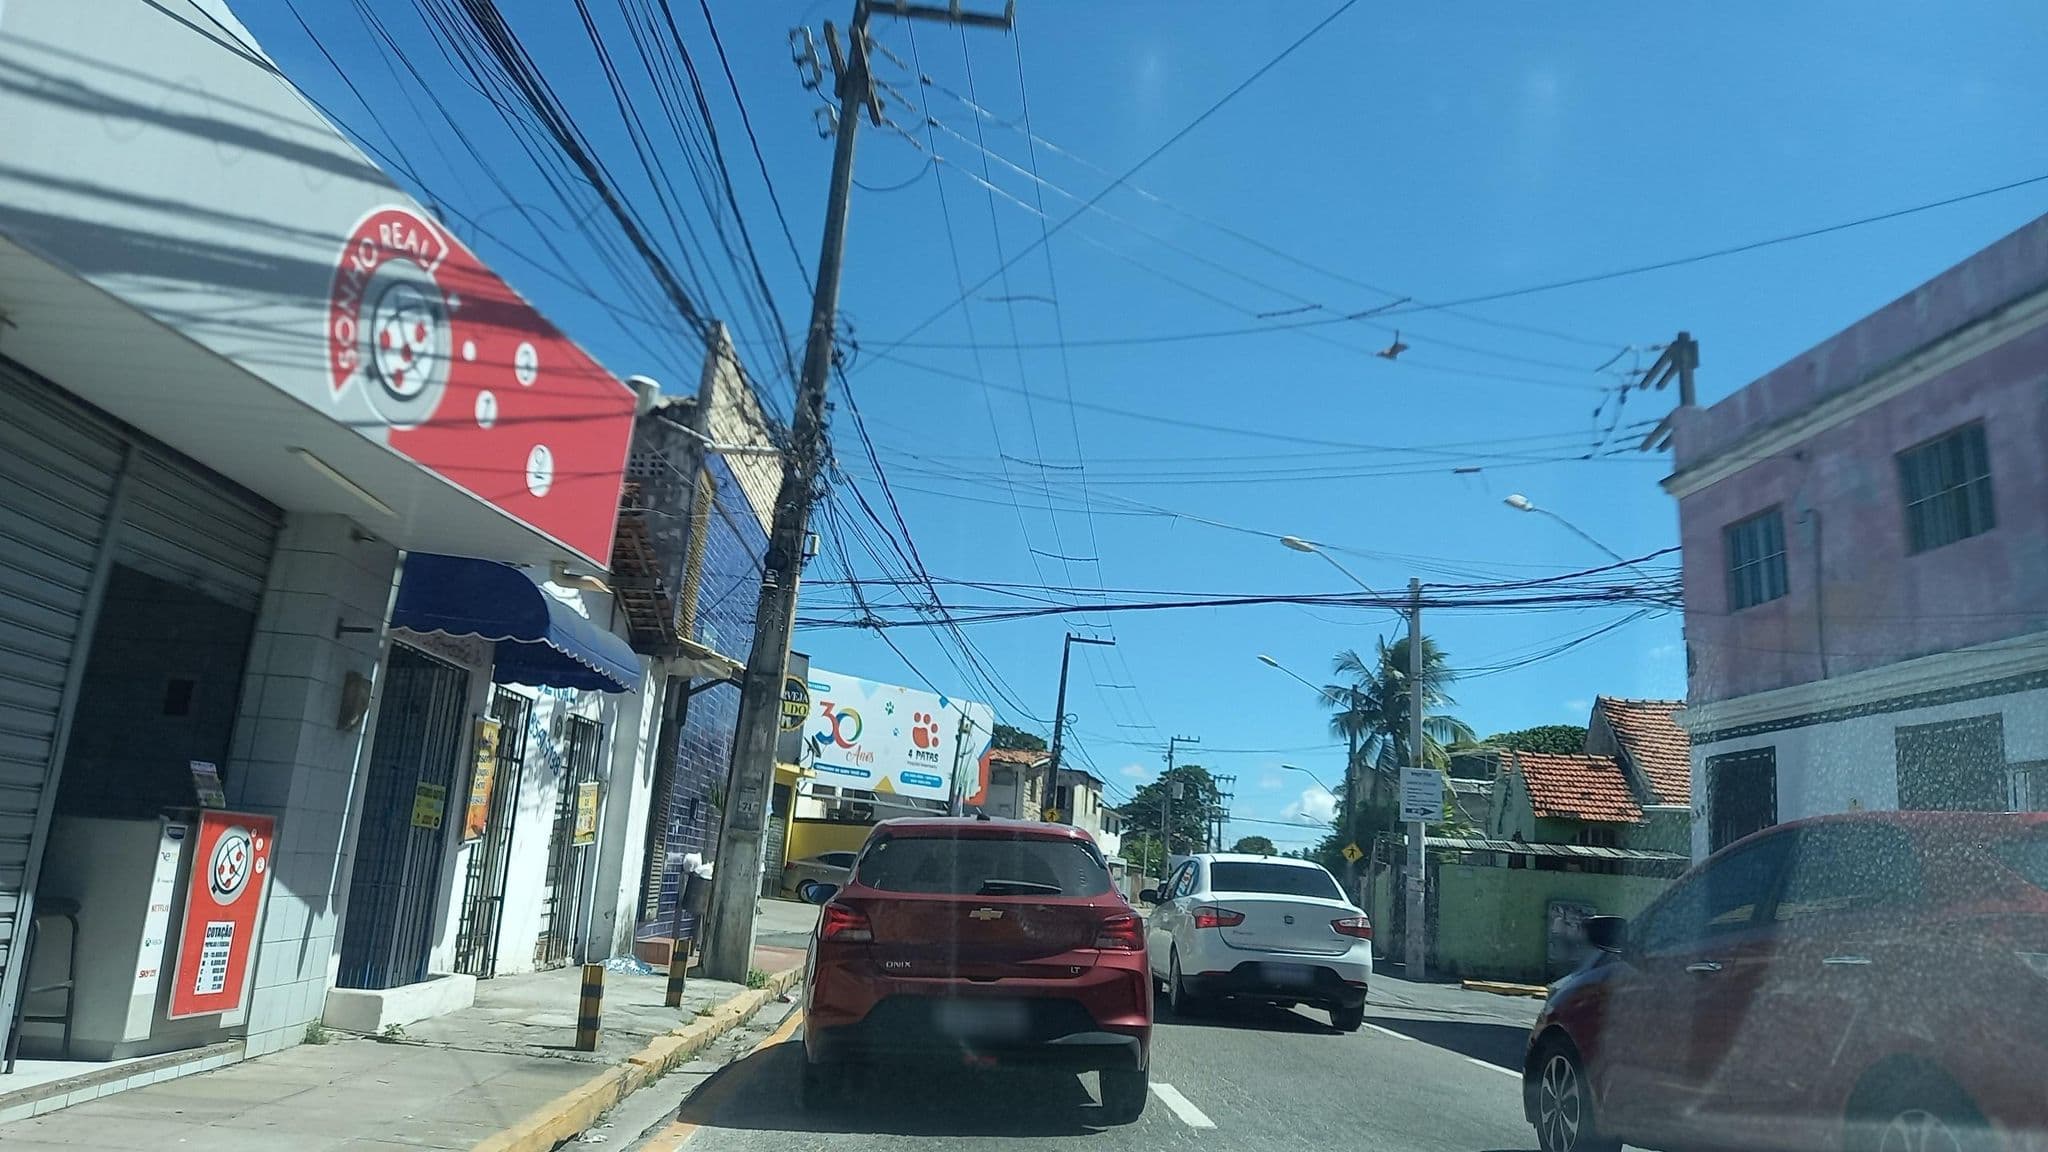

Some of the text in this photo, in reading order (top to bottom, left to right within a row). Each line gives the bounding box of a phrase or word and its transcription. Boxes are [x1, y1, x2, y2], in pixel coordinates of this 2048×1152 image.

[378, 221, 430, 269] REAL
[815, 700, 863, 749] 30
[916, 750, 940, 763] PATAS
[206, 924, 233, 940] COTAÇÃO
[885, 960, 912, 969] ONIX
[1071, 966, 1081, 974] LT
